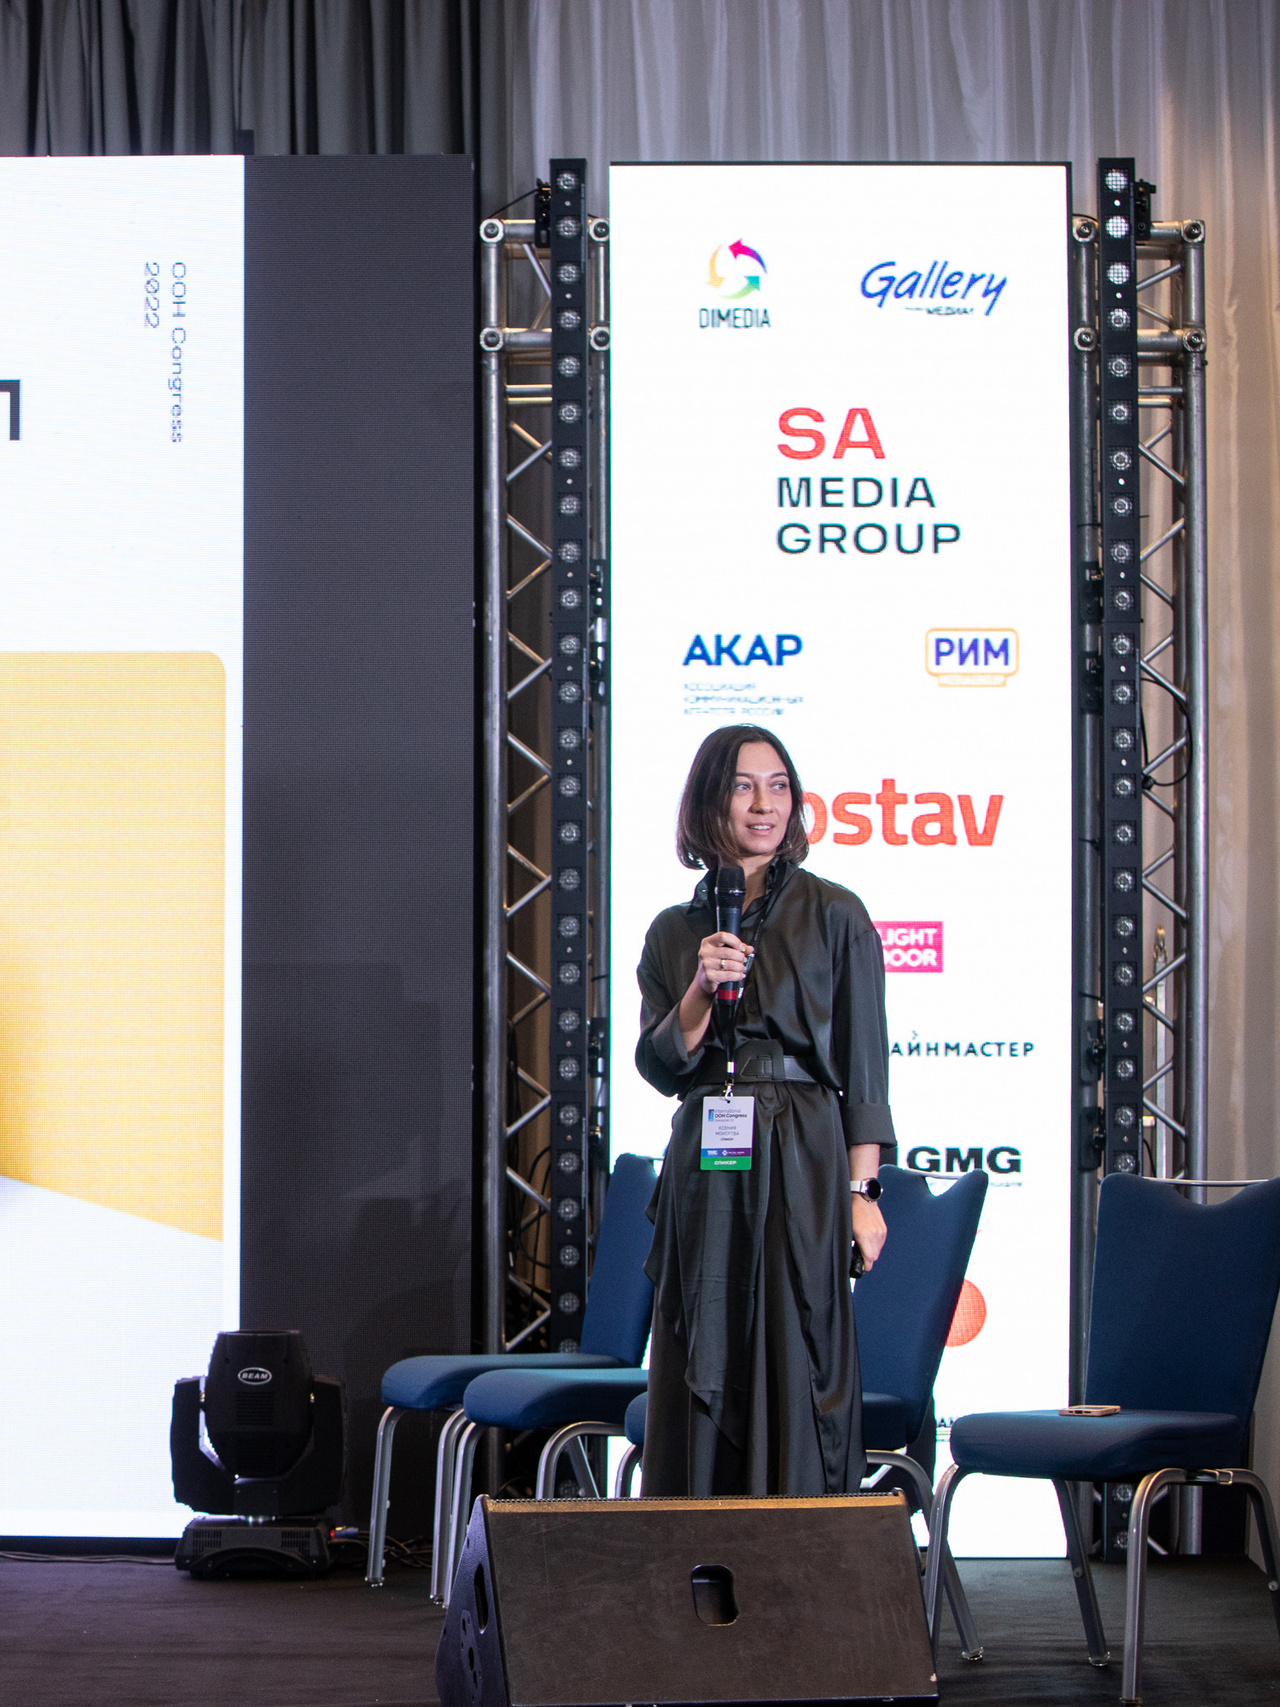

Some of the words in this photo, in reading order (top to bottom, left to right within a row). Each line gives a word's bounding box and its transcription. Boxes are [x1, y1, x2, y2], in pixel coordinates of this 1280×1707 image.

[144, 261, 160, 329] 2022
[171, 261, 187, 318] OOH
[860, 259, 1008, 317] Gallery
[699, 307, 771, 329] DIMEDIA
[167, 327, 187, 443] Congress
[776, 406, 886, 461] SA
[777, 476, 937, 509] MEDIA
[776, 521, 962, 555] GROUP
[682, 633, 804, 667] АКАР
[934, 637, 1010, 667] РИМ
[890, 1030, 1035, 1058] АЙНМАСТЕР
[906, 1145, 1023, 1175] GMG
[241, 1372, 269, 1380] BEAM
